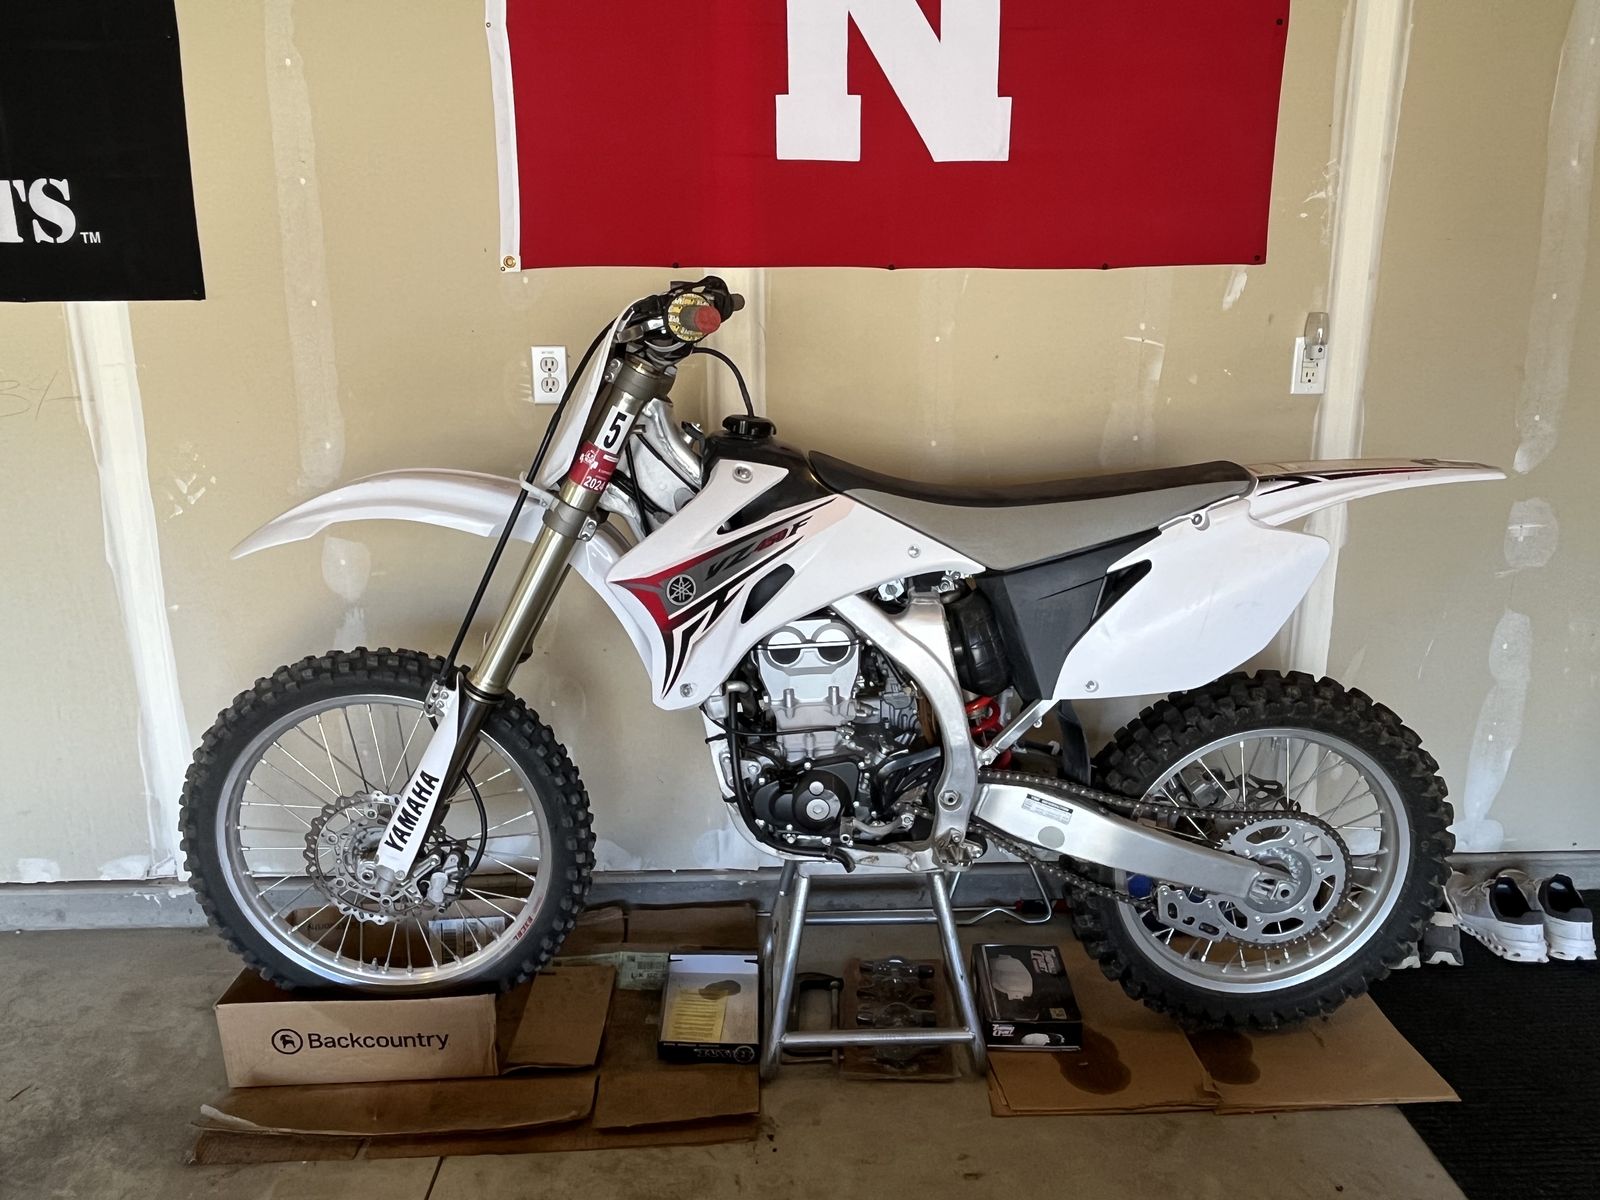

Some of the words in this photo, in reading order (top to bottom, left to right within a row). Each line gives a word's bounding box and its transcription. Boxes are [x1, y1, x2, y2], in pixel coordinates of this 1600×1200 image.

[776, 0, 1012, 162] N
[603, 411, 628, 449] 5
[384, 770, 440, 852] YAMAHA
[307, 1032, 449, 1050] Backcountry
